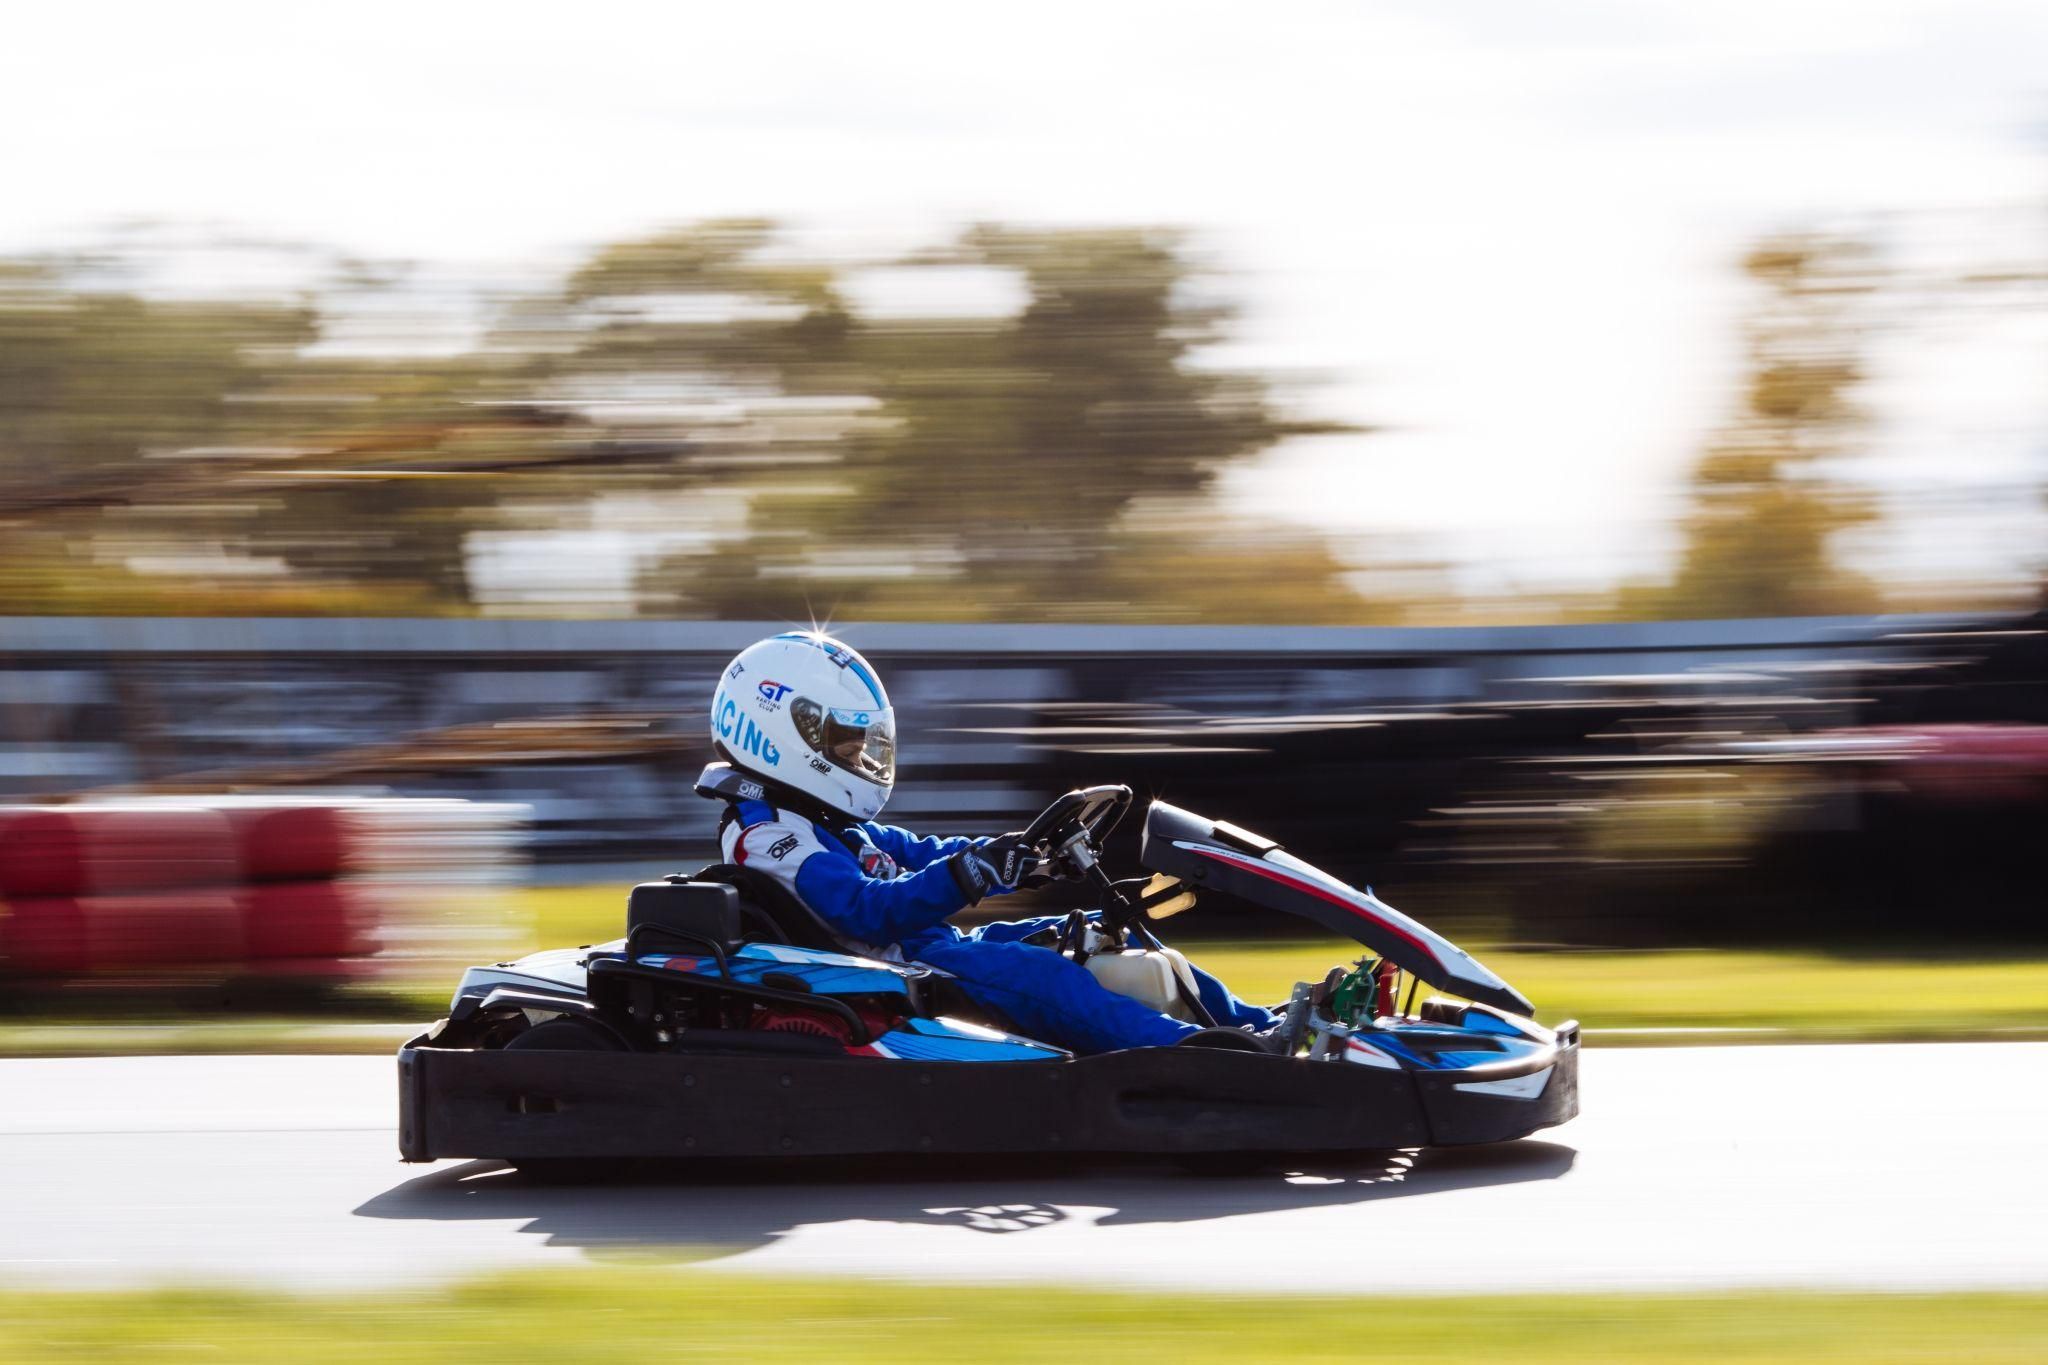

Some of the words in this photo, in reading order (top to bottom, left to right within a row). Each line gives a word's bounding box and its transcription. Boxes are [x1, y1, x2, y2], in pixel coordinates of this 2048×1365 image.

[758, 680, 794, 701] GT
[759, 703, 774, 712] CLUB
[711, 691, 780, 766] ACING
[810, 758, 832, 774] OMP
[769, 836, 799, 860] OMP
